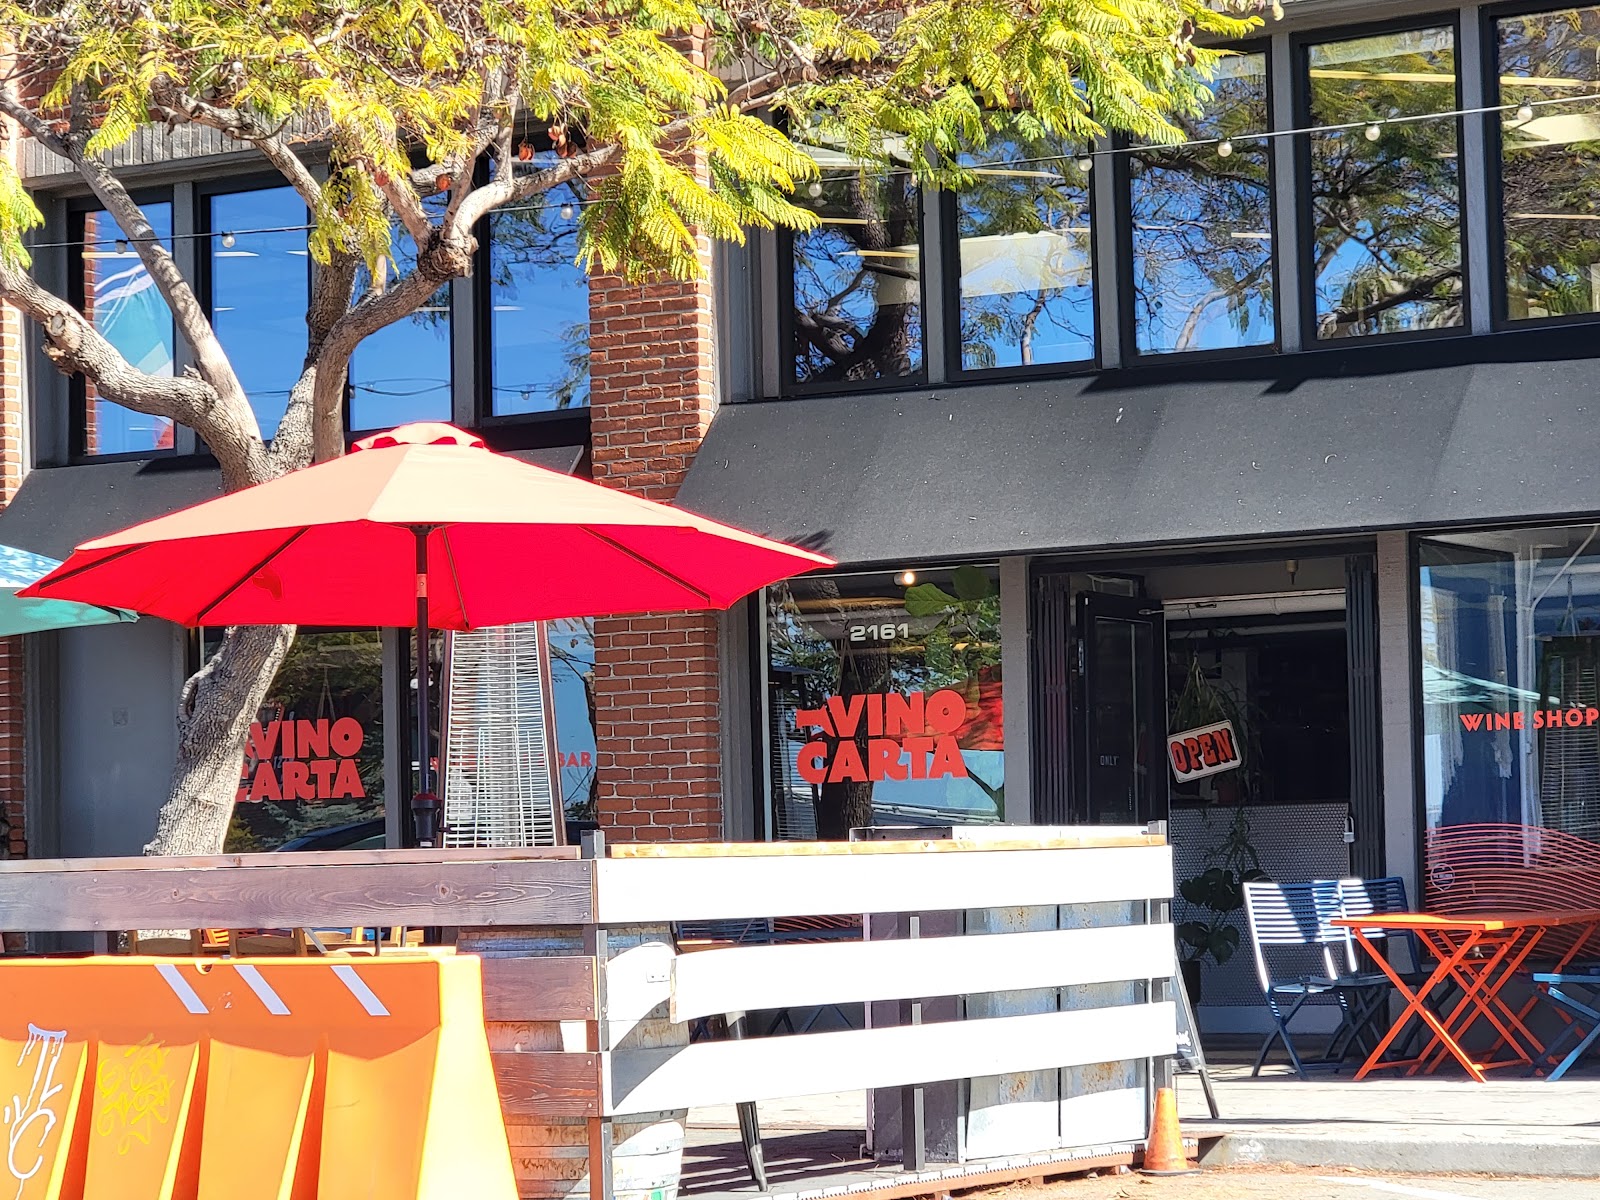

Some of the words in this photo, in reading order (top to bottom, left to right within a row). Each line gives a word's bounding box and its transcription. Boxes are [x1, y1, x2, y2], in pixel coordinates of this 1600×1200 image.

[849, 622, 909, 642] 2161
[826, 689, 967, 738] VINO
[1460, 711, 1525, 732] WINE
[1532, 707, 1600, 729] SHOP
[250, 716, 364, 760] VINO
[796, 736, 969, 784] CARTA
[1171, 728, 1238, 774] OPEN
